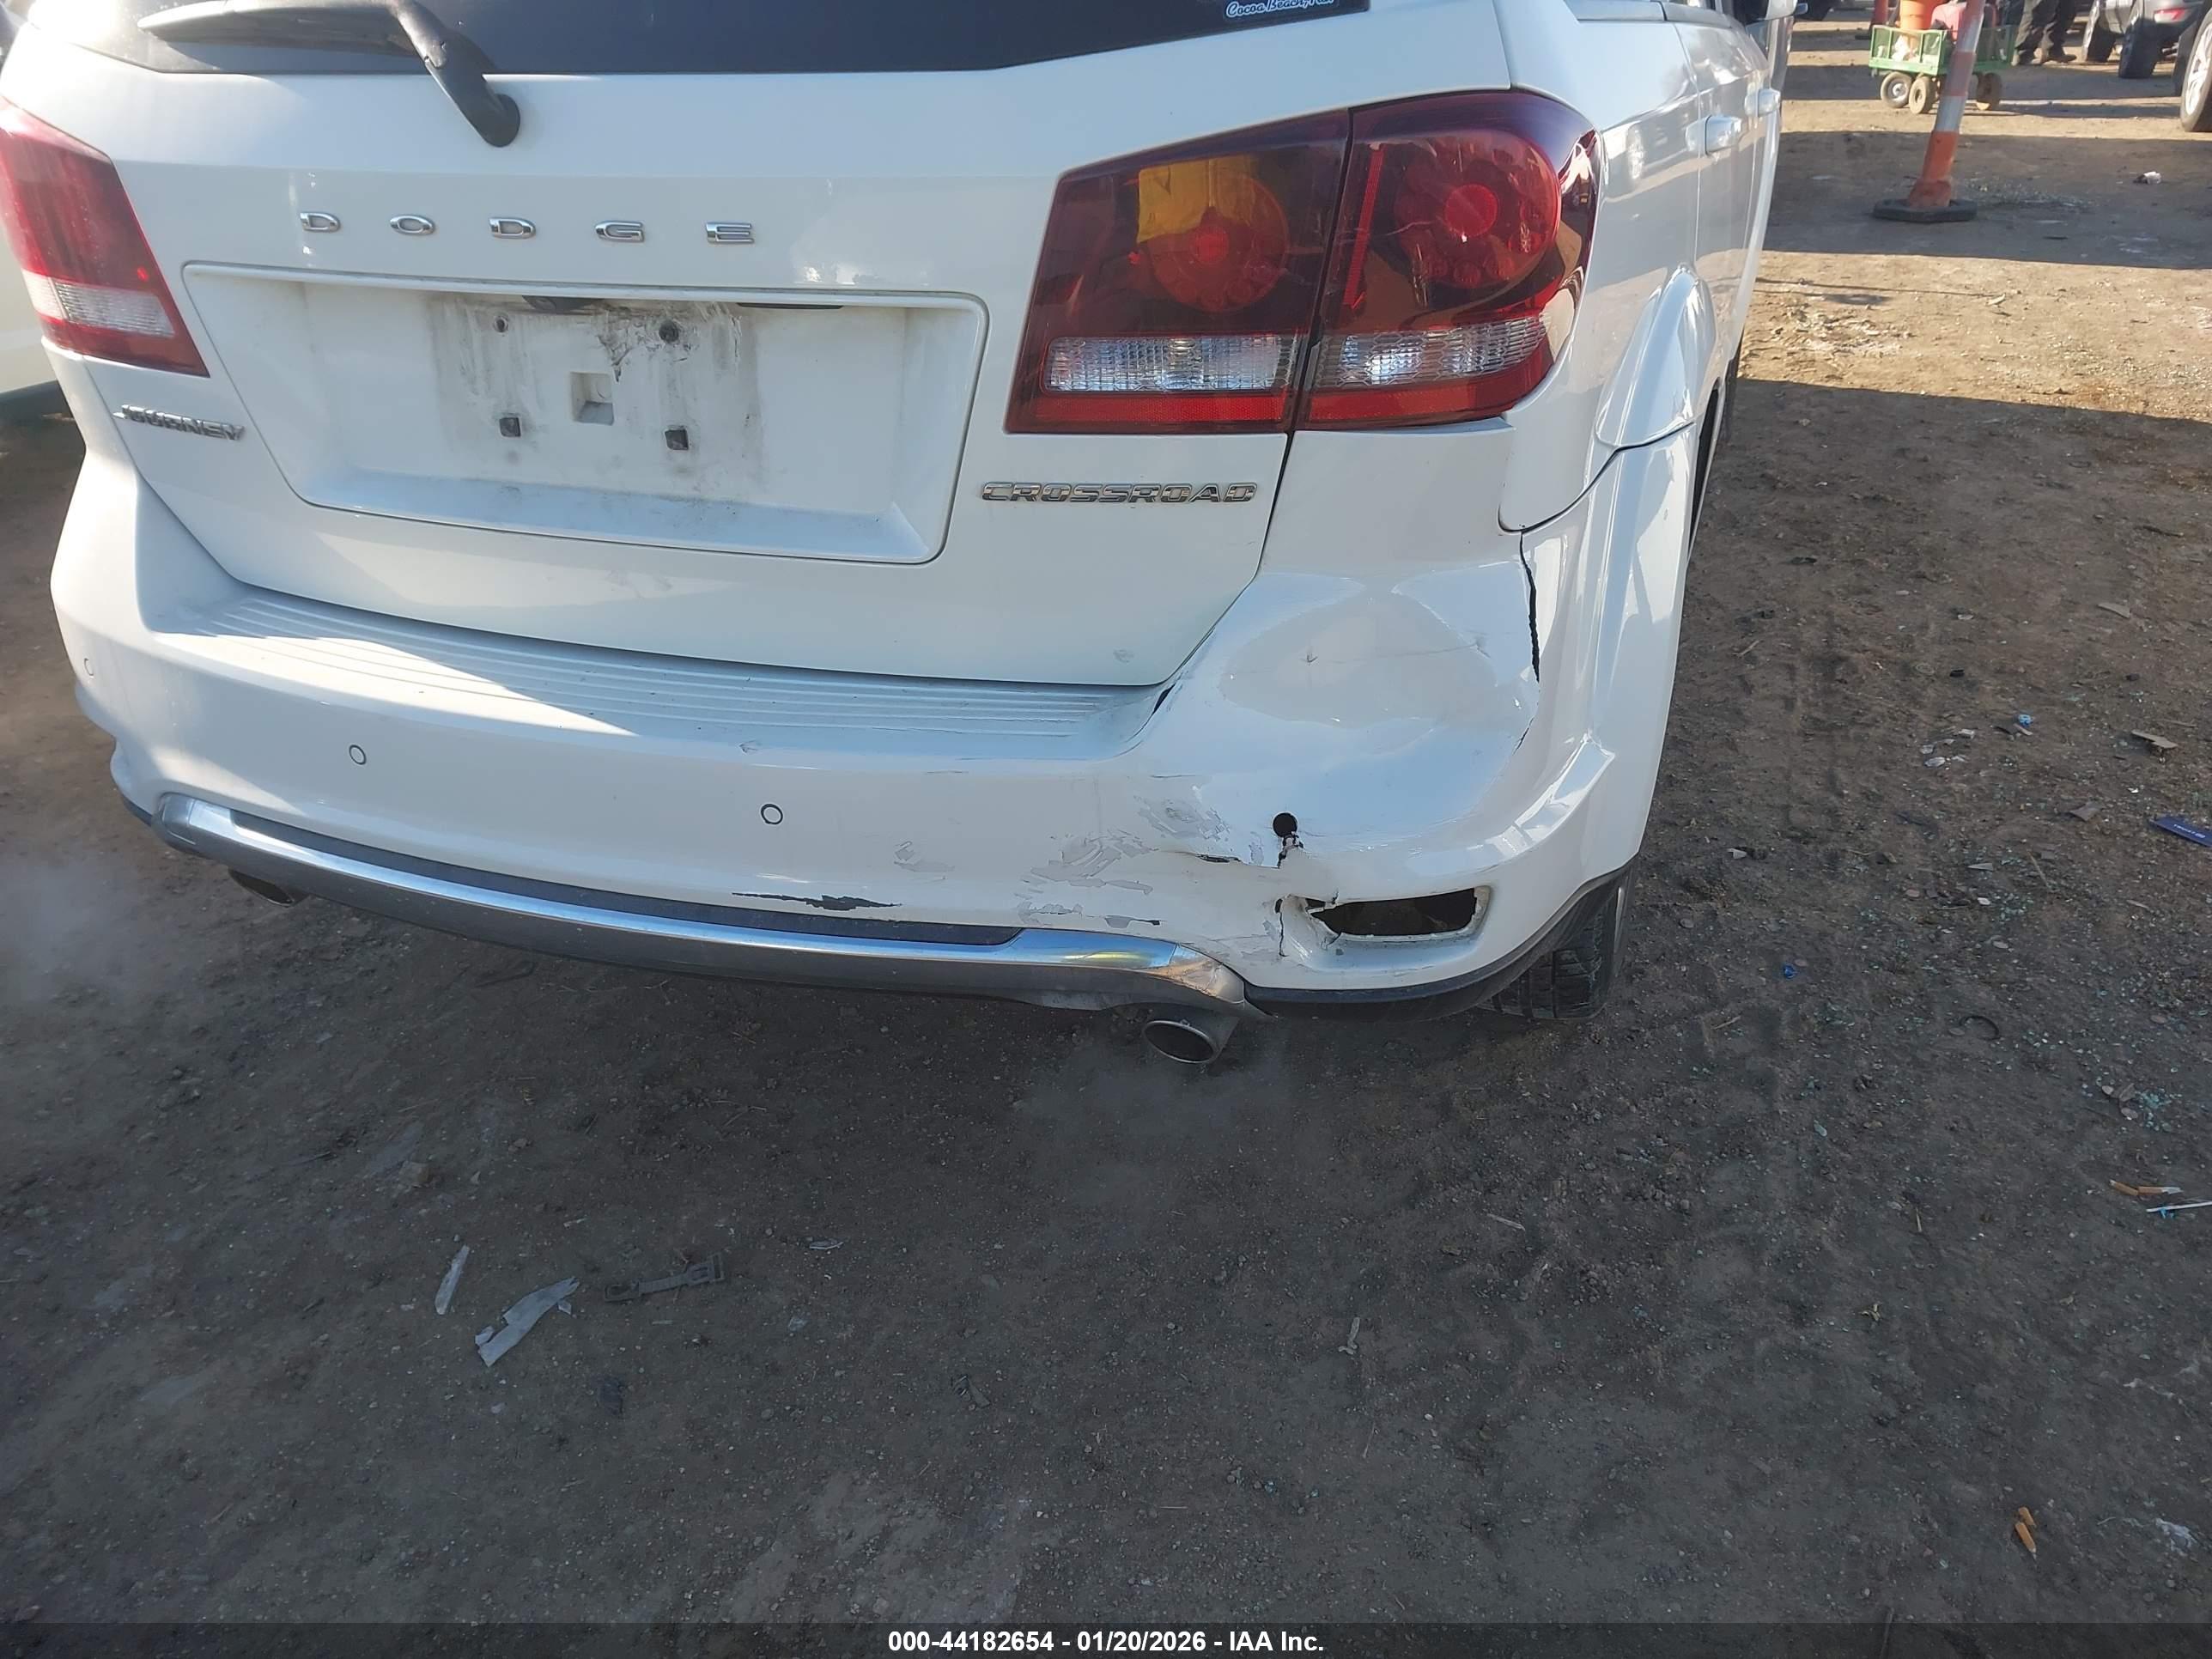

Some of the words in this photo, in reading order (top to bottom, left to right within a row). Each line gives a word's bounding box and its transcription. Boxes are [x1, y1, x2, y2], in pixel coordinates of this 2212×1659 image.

[1227, 2, 1265, 18] Cocoa
[301, 211, 754, 244] DODGE
[981, 481, 1258, 502] CROSSROAD
